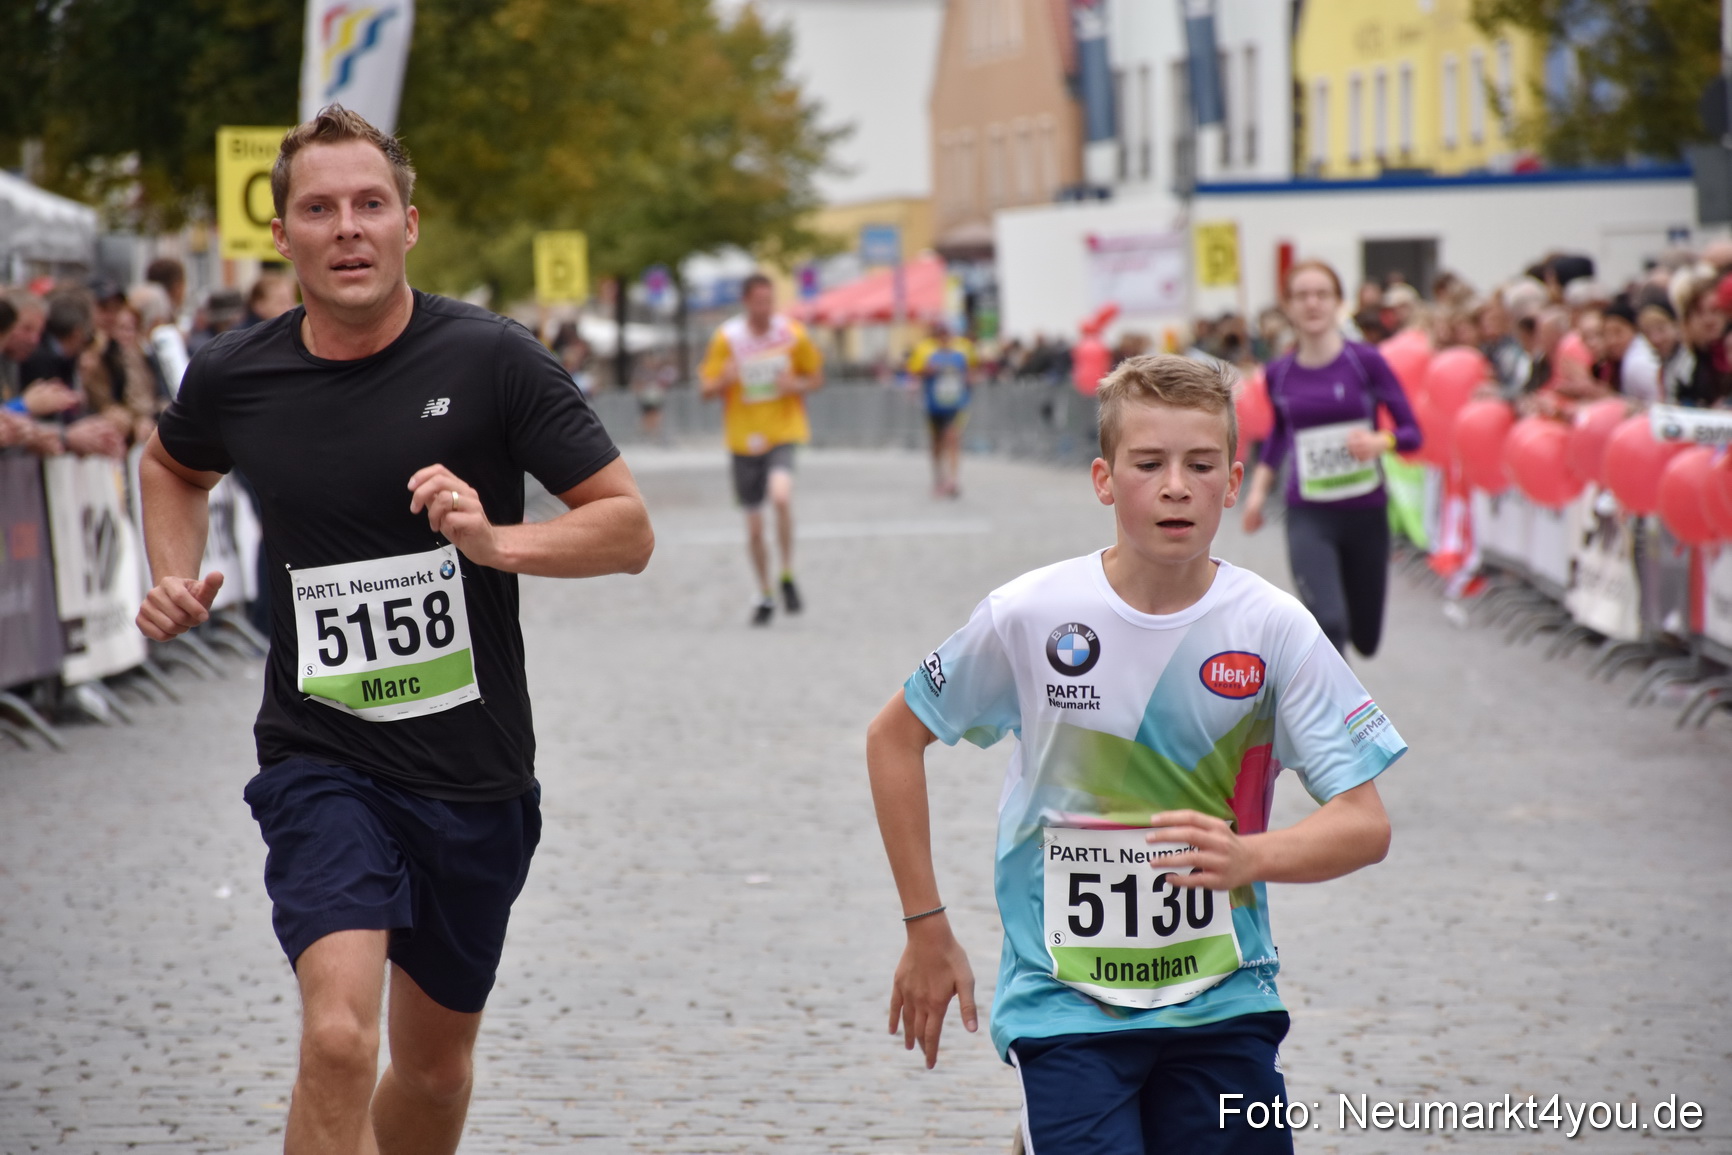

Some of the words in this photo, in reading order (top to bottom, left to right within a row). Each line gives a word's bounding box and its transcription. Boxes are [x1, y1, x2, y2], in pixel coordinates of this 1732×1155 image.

[296, 582, 346, 601] PARTL
[350, 570, 434, 595] Neumarkt
[315, 590, 455, 667] 5158
[1051, 624, 1096, 642] BMW
[1211, 662, 1260, 687] Hervis
[361, 676, 421, 702] Marc
[1046, 684, 1100, 699] PARTL
[1048, 698, 1100, 710] Neumarkt
[1050, 845, 1115, 863] PARTL
[1120, 844, 1199, 864] Neumar
[1067, 867, 1214, 938] 5130
[1090, 954, 1199, 982] Jonathan
